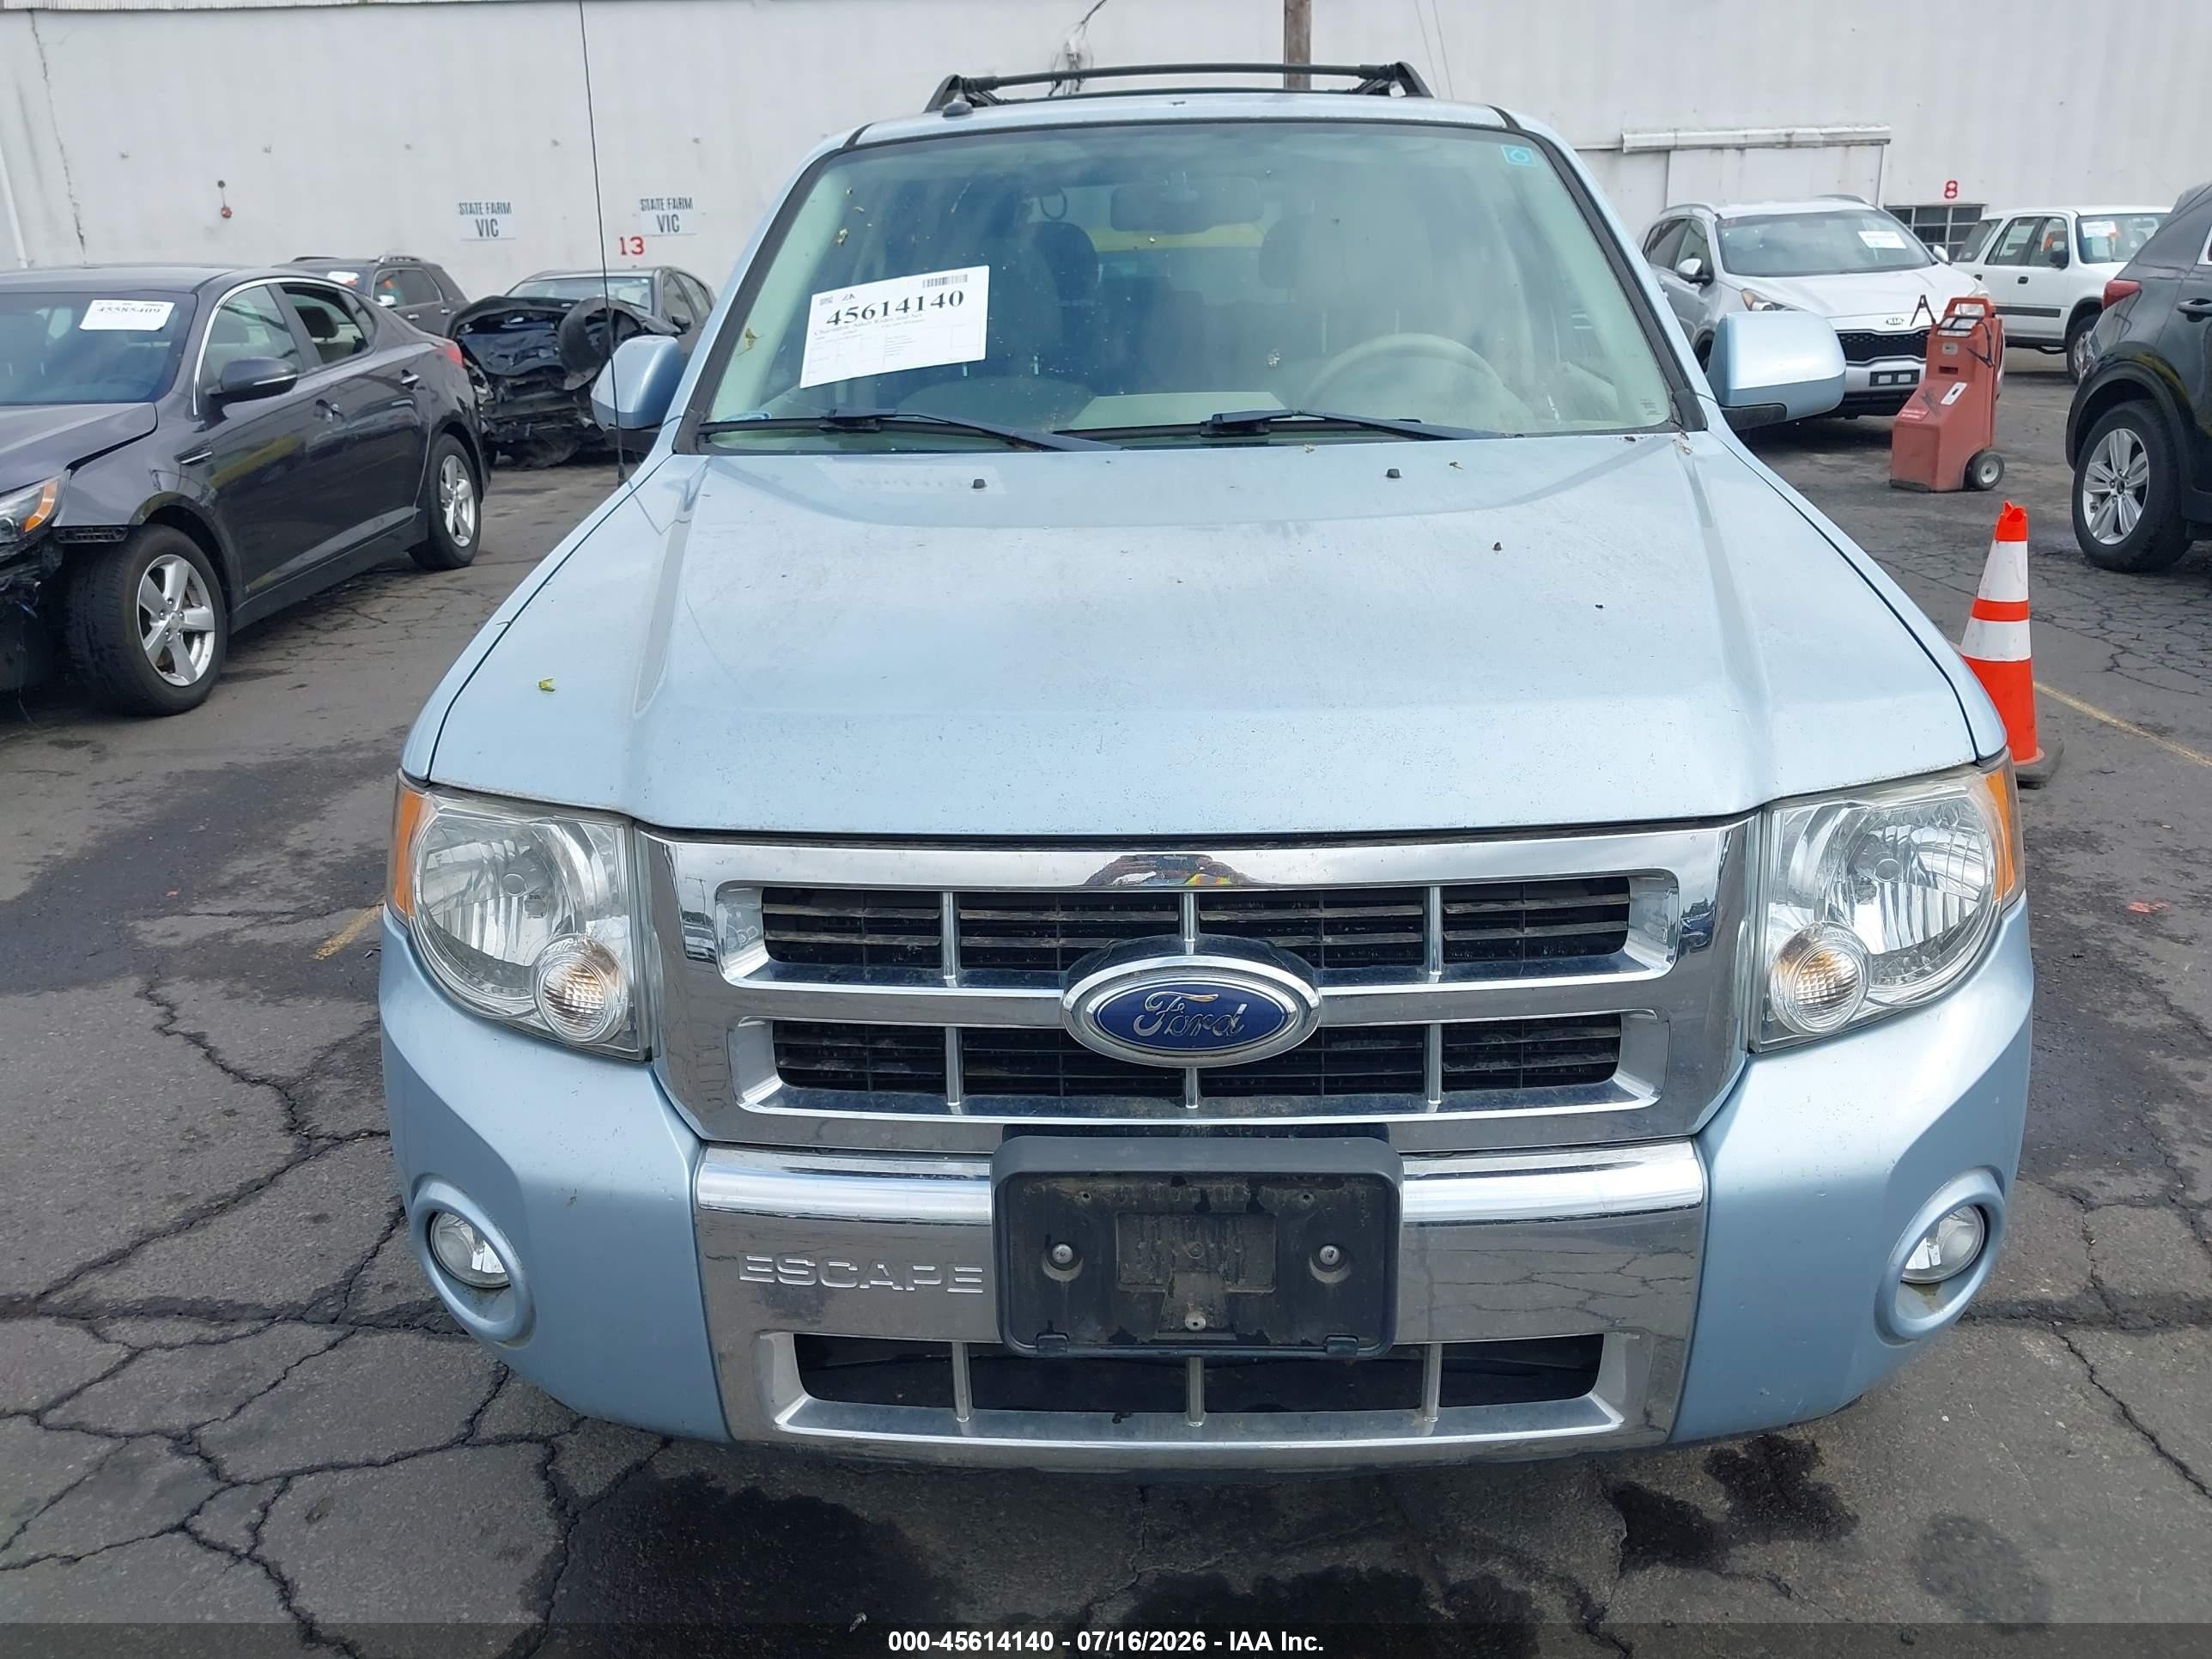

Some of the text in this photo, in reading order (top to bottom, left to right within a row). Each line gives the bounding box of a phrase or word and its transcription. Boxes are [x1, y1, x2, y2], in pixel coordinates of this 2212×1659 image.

[1944, 179, 1959, 199] 8
[459, 201, 512, 216] STATE FARM
[640, 197, 693, 211] STATE FARM
[476, 218, 499, 238] VIC
[657, 214, 680, 234] VIC
[619, 236, 645, 255] 13
[826, 290, 964, 325] 45614140
[1886, 317, 1904, 325] KIA
[1133, 990, 1248, 1037] Ford
[738, 1253, 984, 1294] ESCAPE
